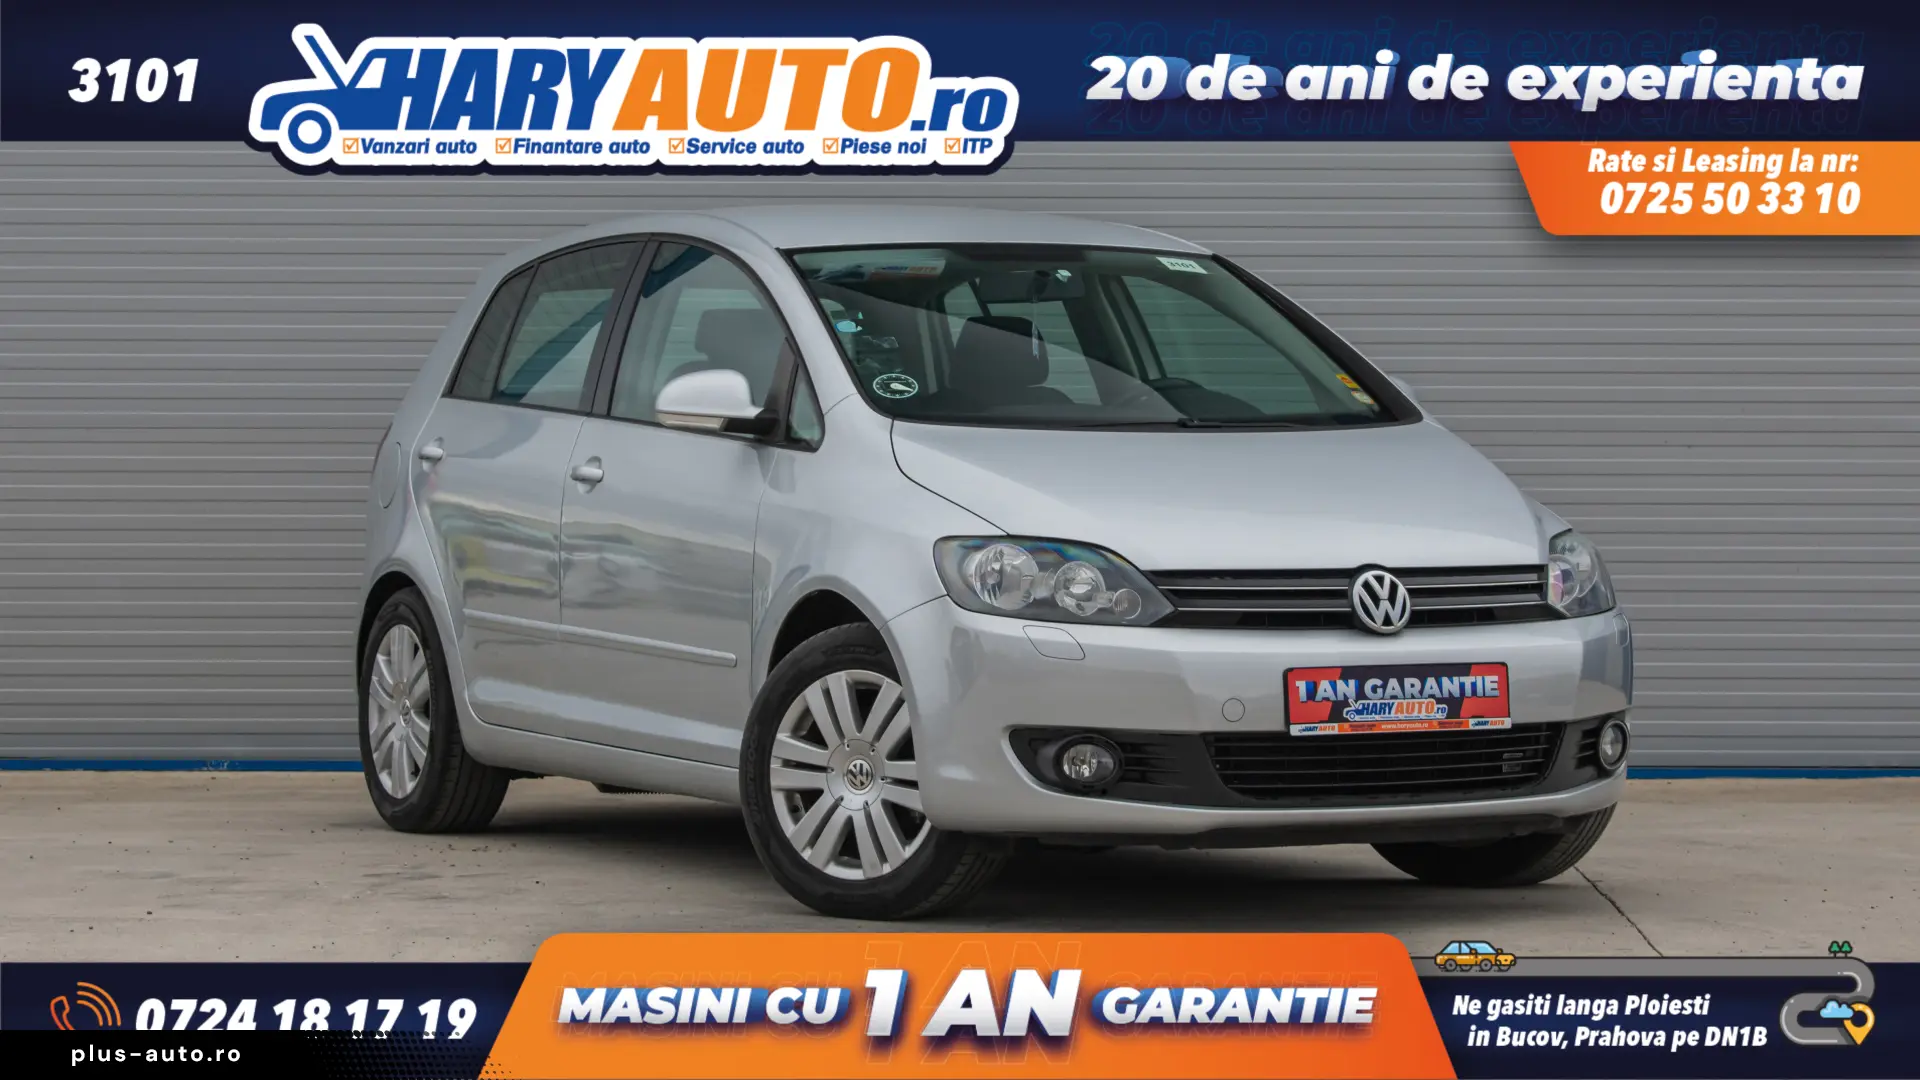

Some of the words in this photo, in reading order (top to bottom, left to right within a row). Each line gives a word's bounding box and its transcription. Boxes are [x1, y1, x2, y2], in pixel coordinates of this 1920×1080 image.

[1296, 680, 1309, 702] 1
[1314, 679, 1357, 701] AN
[1364, 675, 1500, 700] GARANTIE
